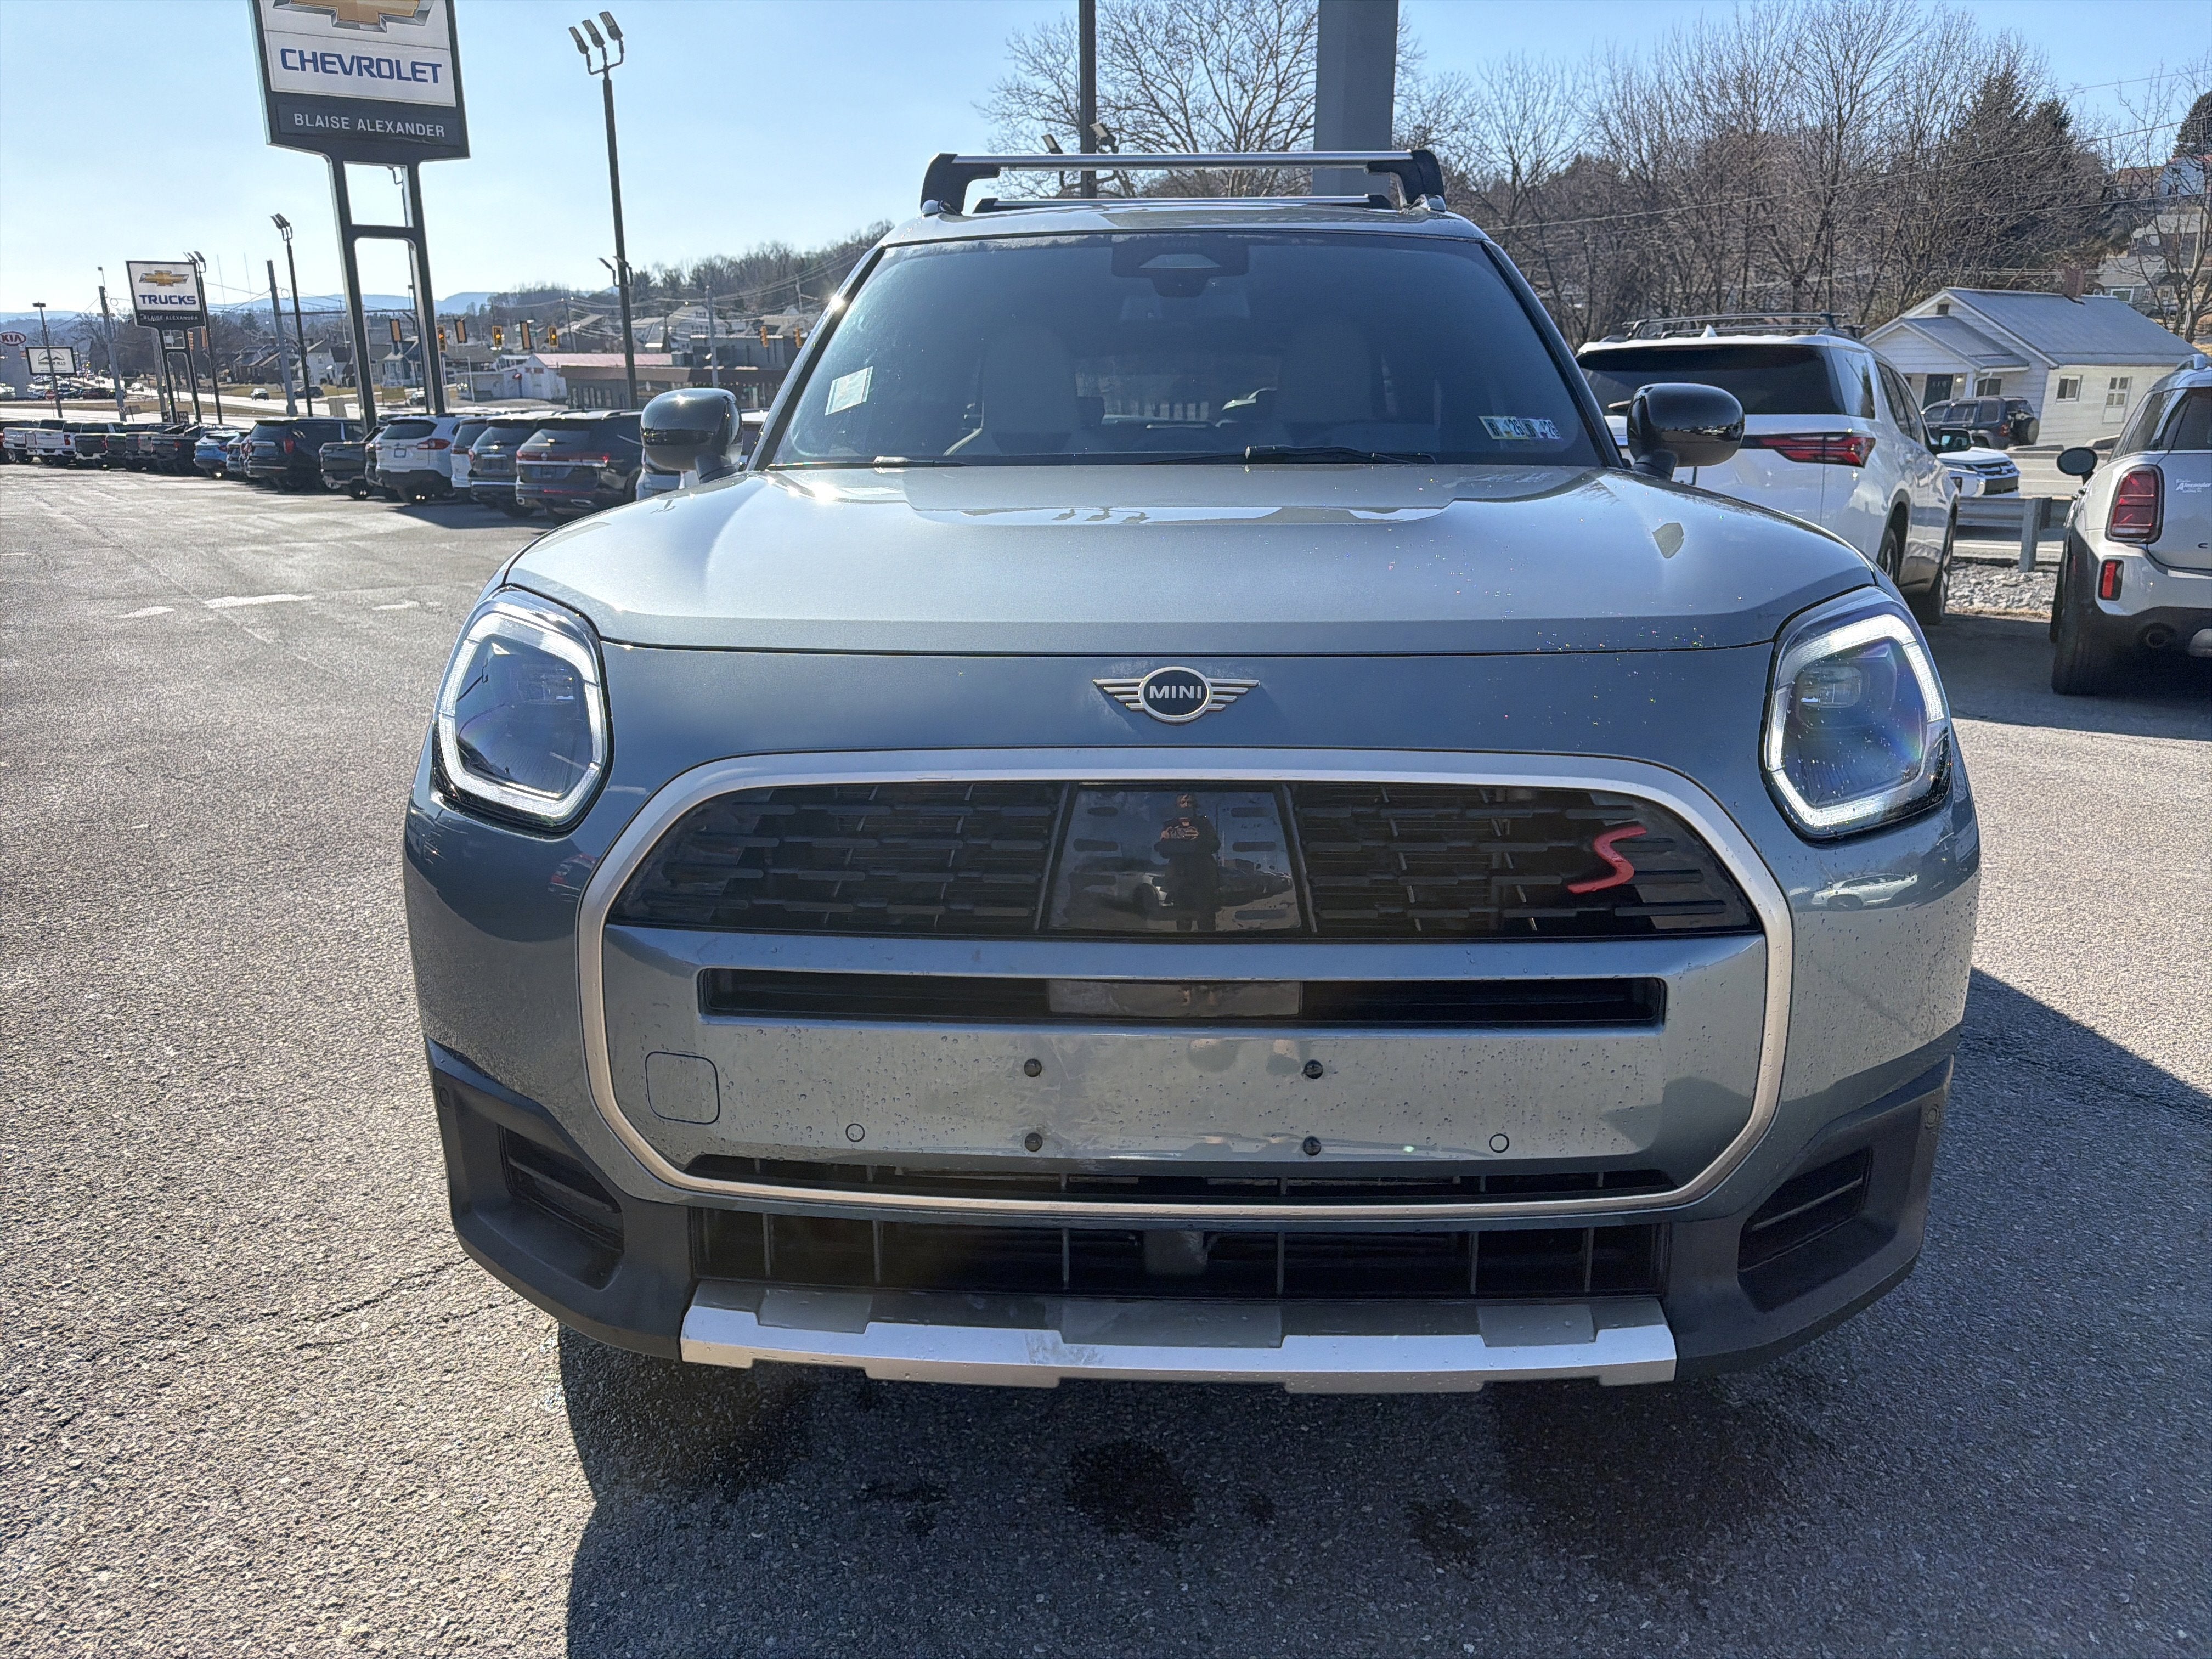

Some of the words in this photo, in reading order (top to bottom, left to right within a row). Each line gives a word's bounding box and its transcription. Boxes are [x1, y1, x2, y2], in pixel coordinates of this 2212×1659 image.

[280, 48, 442, 84] CHEVROLET
[294, 113, 351, 129] BLAISE
[357, 119, 445, 137] ALEXANDER
[139, 294, 196, 305] TRUCKS
[1149, 685, 1202, 699] MINI
[1567, 825, 1647, 894] S
